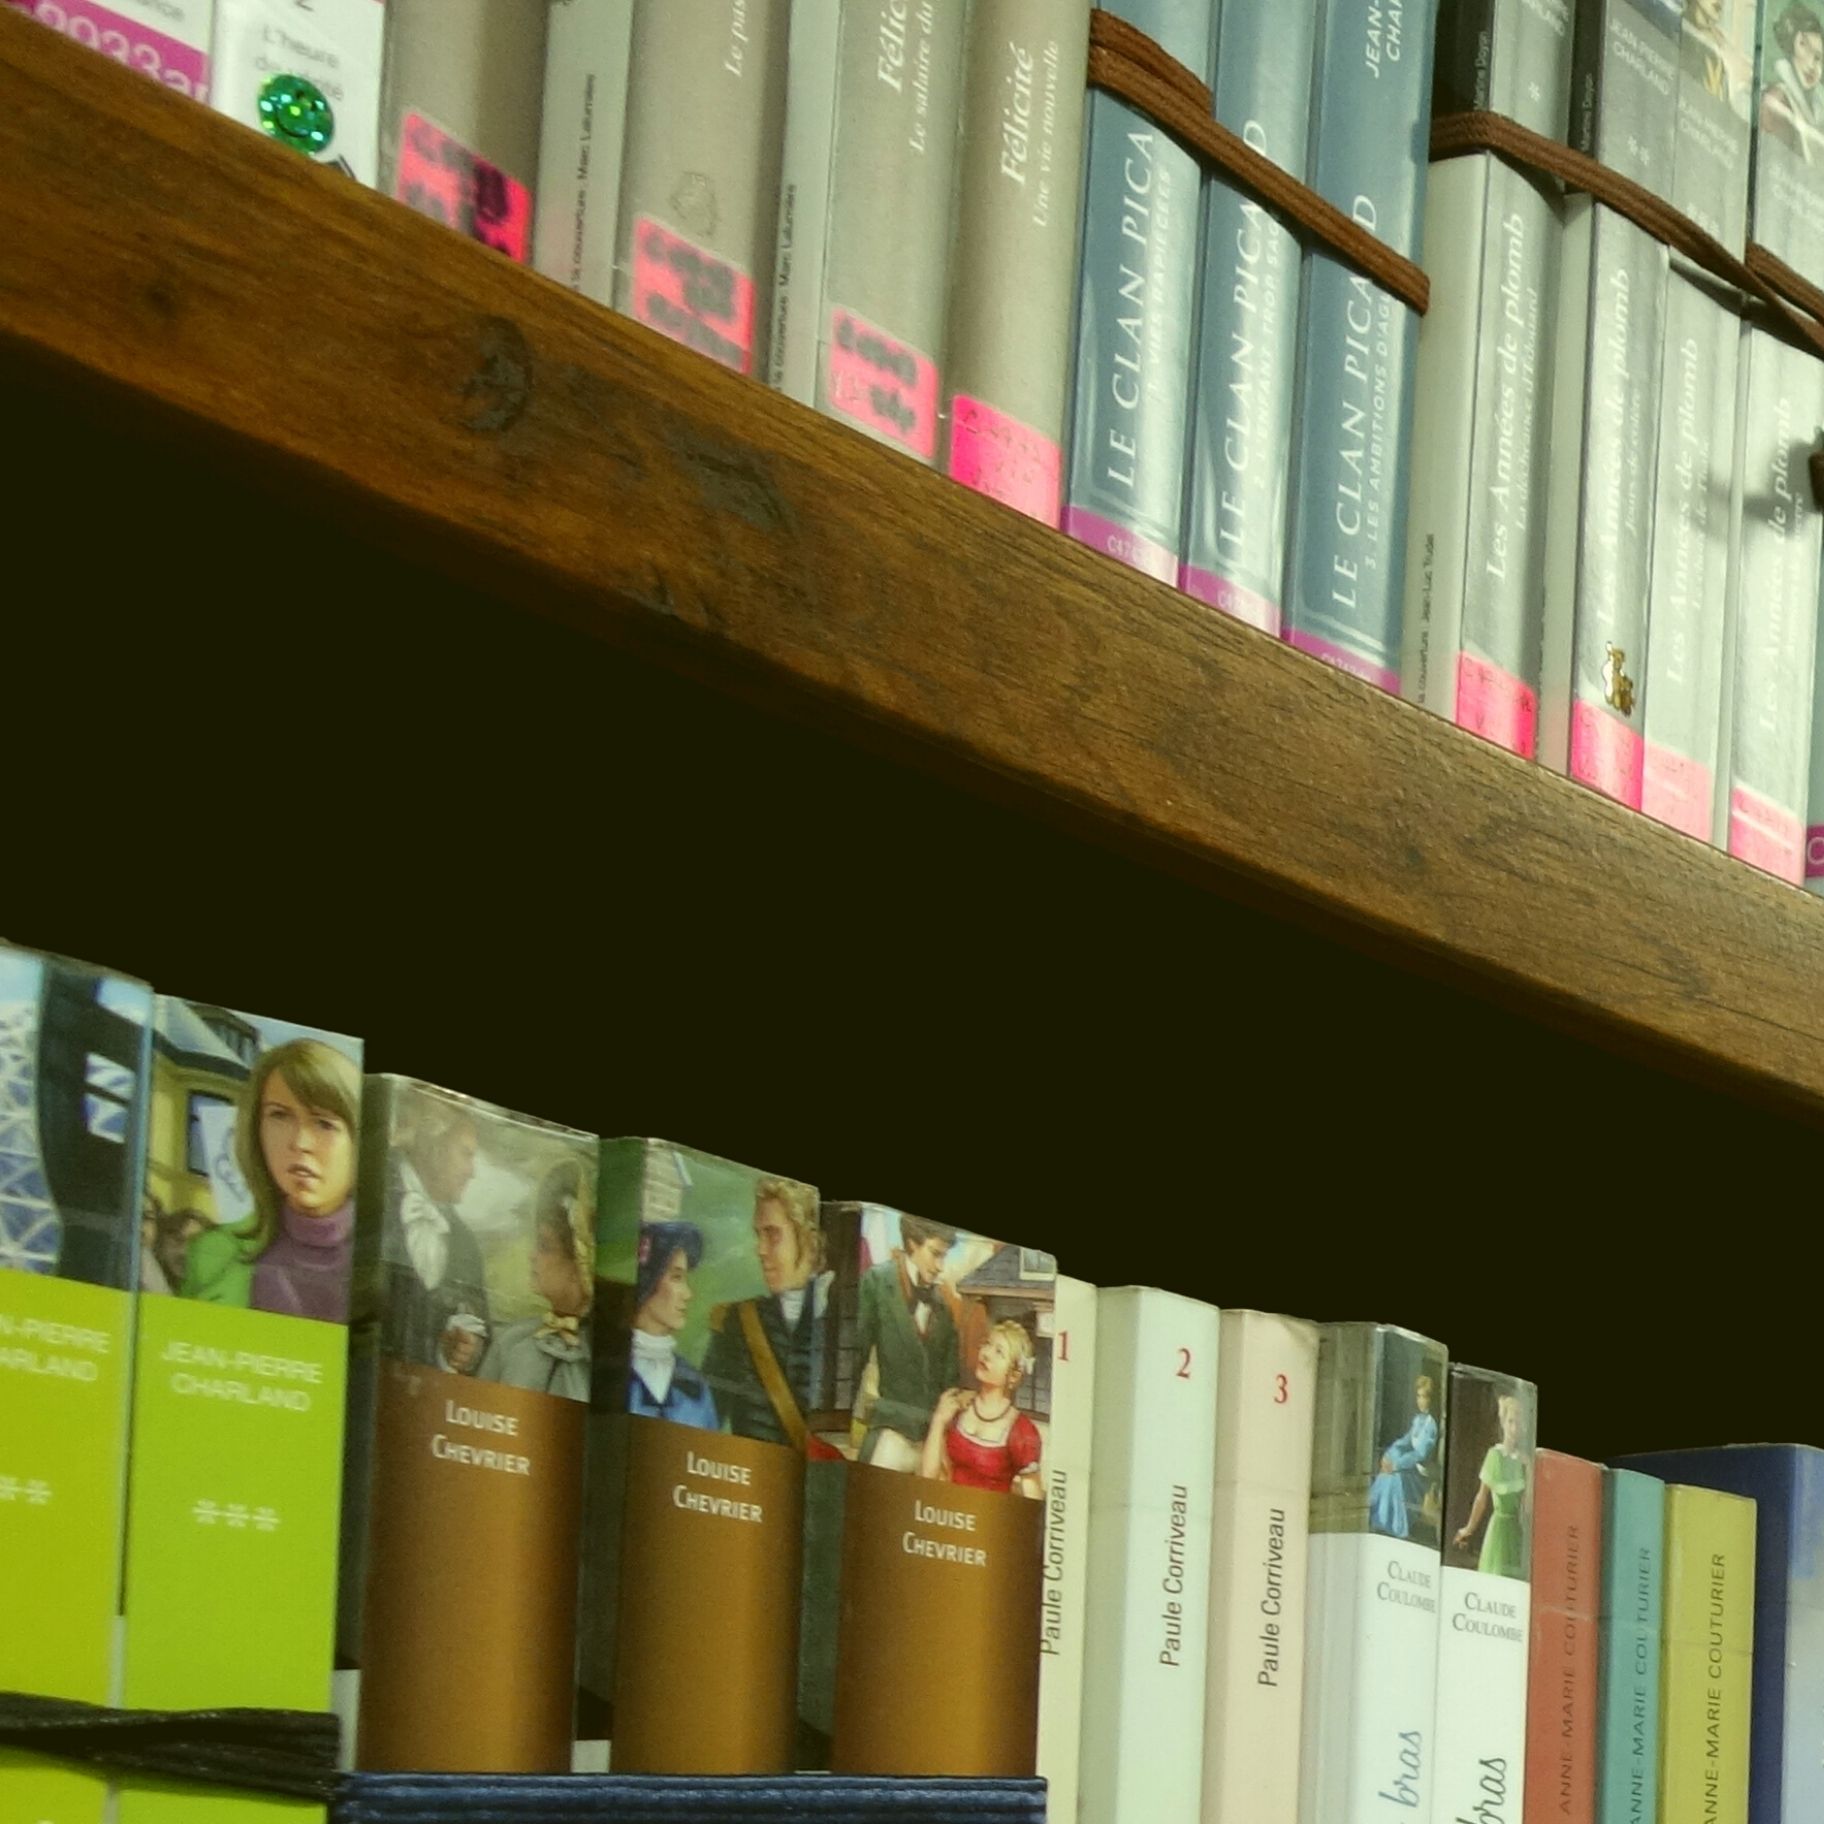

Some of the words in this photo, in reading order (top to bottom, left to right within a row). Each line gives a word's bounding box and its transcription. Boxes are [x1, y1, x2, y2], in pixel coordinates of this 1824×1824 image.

[1000, 40, 1035, 187] Félicité
[1042, 40, 1059, 136] nouvelle
[1036, 145, 1052, 173] vie
[1031, 179, 1051, 228] Une
[1500, 212, 1526, 327] plomb
[1112, 264, 1149, 411] CLAN
[1608, 267, 1632, 377] plomb
[1496, 333, 1520, 377] de
[1225, 333, 1256, 472] CLAN
[1606, 385, 1627, 427] de
[1677, 337, 1700, 442] plomb
[1370, 363, 1391, 491] AMBITIONS
[1488, 385, 1519, 508] Années
[1771, 397, 1794, 500] plomb
[1107, 429, 1136, 489] LE
[1336, 401, 1366, 536] CLAN
[1673, 448, 1695, 491] de
[1220, 491, 1248, 547] LE
[1367, 502, 1380, 541] LES
[1598, 434, 1625, 554] Années
[1768, 506, 1788, 542] de
[1332, 555, 1358, 610] LE
[1485, 522, 1510, 585] Les
[1669, 500, 1692, 619] Années
[1596, 564, 1620, 626] Les
[1761, 552, 1786, 671] Années
[1665, 629, 1688, 687] Les
[1758, 682, 1779, 733] Les
[159, 1338, 326, 1388] JEAN-PIERRE
[1057, 1331, 1071, 1363] 1
[1176, 1347, 1192, 1379] 2
[169, 1370, 313, 1416] CHARLAND
[443, 1398, 520, 1439] LOUISE
[1272, 1374, 1288, 1405] 3
[430, 1432, 532, 1478] CHEVRIER
[686, 1451, 753, 1487] LOUISE
[672, 1484, 764, 1525] CHEVRIER
[913, 1500, 977, 1533] LOUISE
[1043, 1469, 1067, 1582] Corriveau
[901, 1530, 988, 1569] CHEVRIER
[1162, 1485, 1187, 1594] Corriveau
[1260, 1508, 1285, 1616] Corriveau
[1041, 1589, 1063, 1656] Paule
[1159, 1601, 1182, 1666] Paule
[1451, 1612, 1524, 1643] COULOMBE
[1463, 1592, 1517, 1620] CLAUDE
[1635, 1547, 1651, 1677] COUTURIER
[1707, 1553, 1727, 1681] COUTURIER
[1257, 1623, 1280, 1687] Paule
[1377, 1730, 1423, 1812] bras
